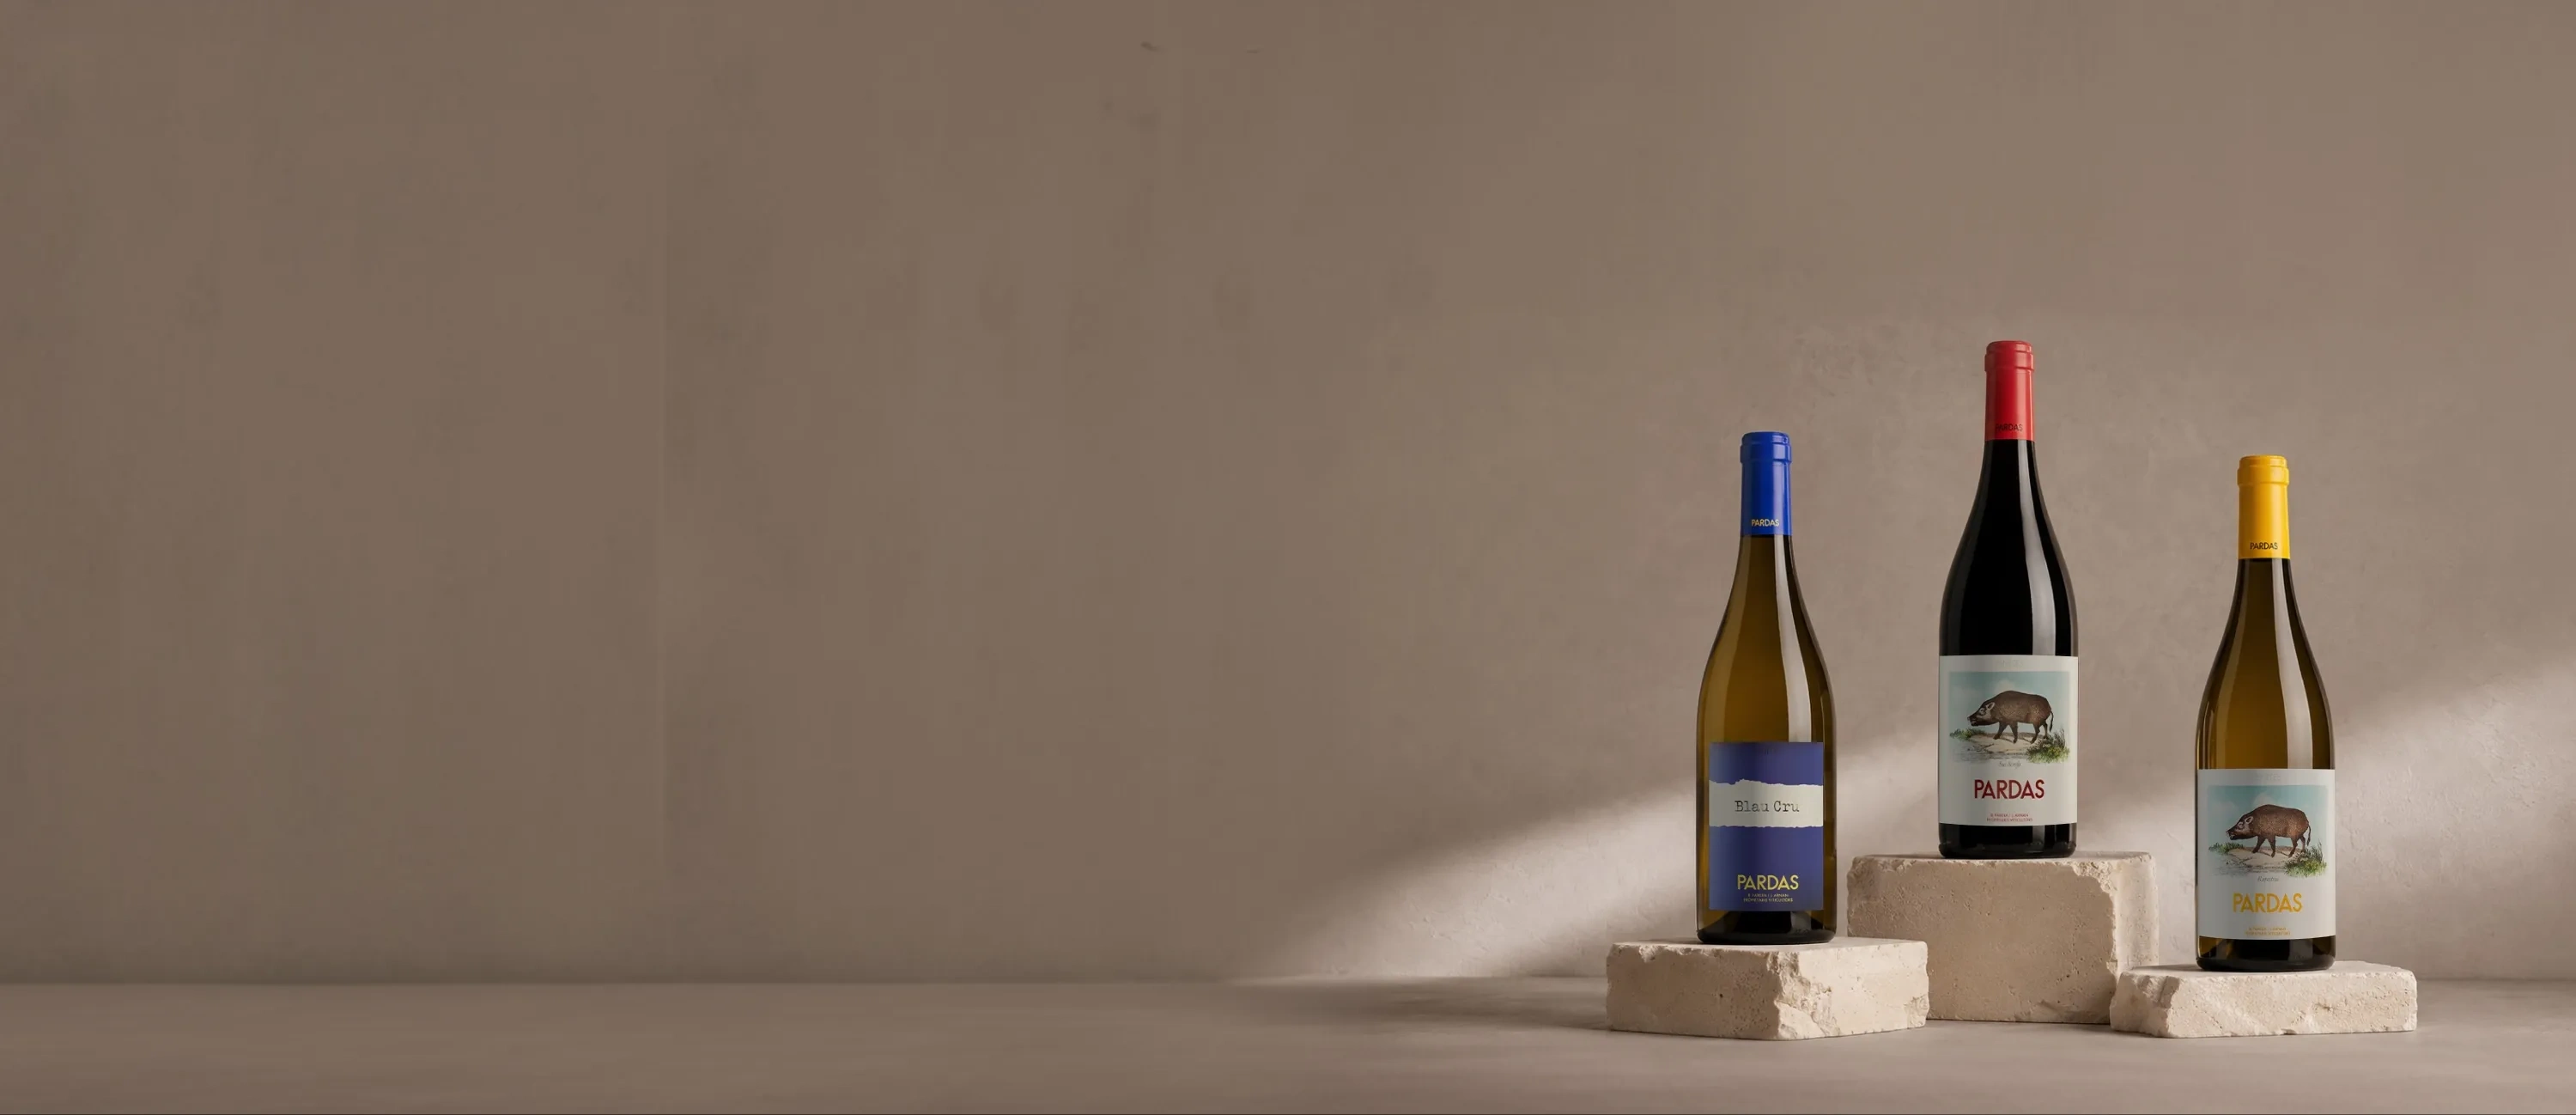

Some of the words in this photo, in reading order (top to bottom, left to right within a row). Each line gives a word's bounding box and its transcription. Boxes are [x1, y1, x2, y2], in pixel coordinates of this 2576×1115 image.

[1974, 779, 2044, 799] PARDAS
[1735, 801, 1770, 812] Blau
[1773, 801, 1800, 812] Cru
[1737, 874, 1799, 890] PARDAS
[2233, 893, 2303, 912] PARDAS
